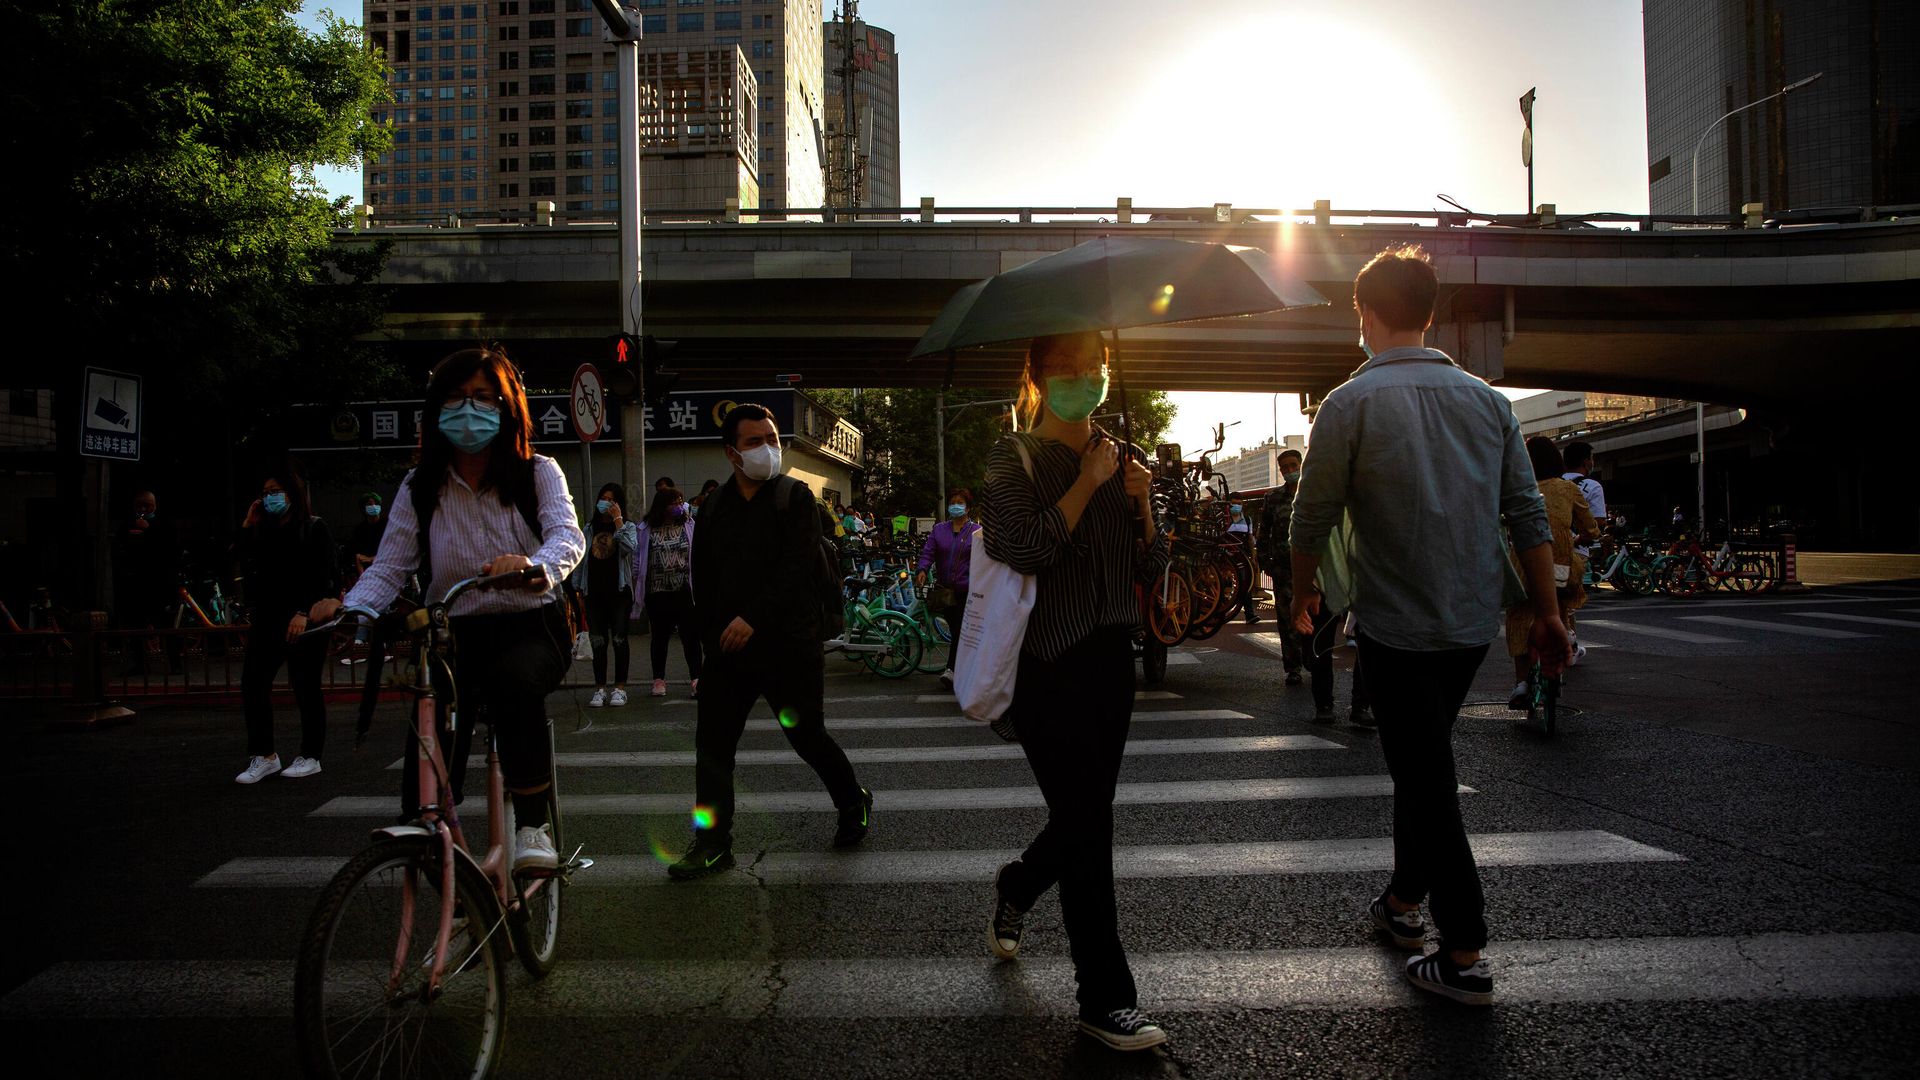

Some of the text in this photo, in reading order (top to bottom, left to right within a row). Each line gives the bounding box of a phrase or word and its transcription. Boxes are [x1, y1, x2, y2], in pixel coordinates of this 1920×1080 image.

[85, 434, 137, 455] 违法停车监测
